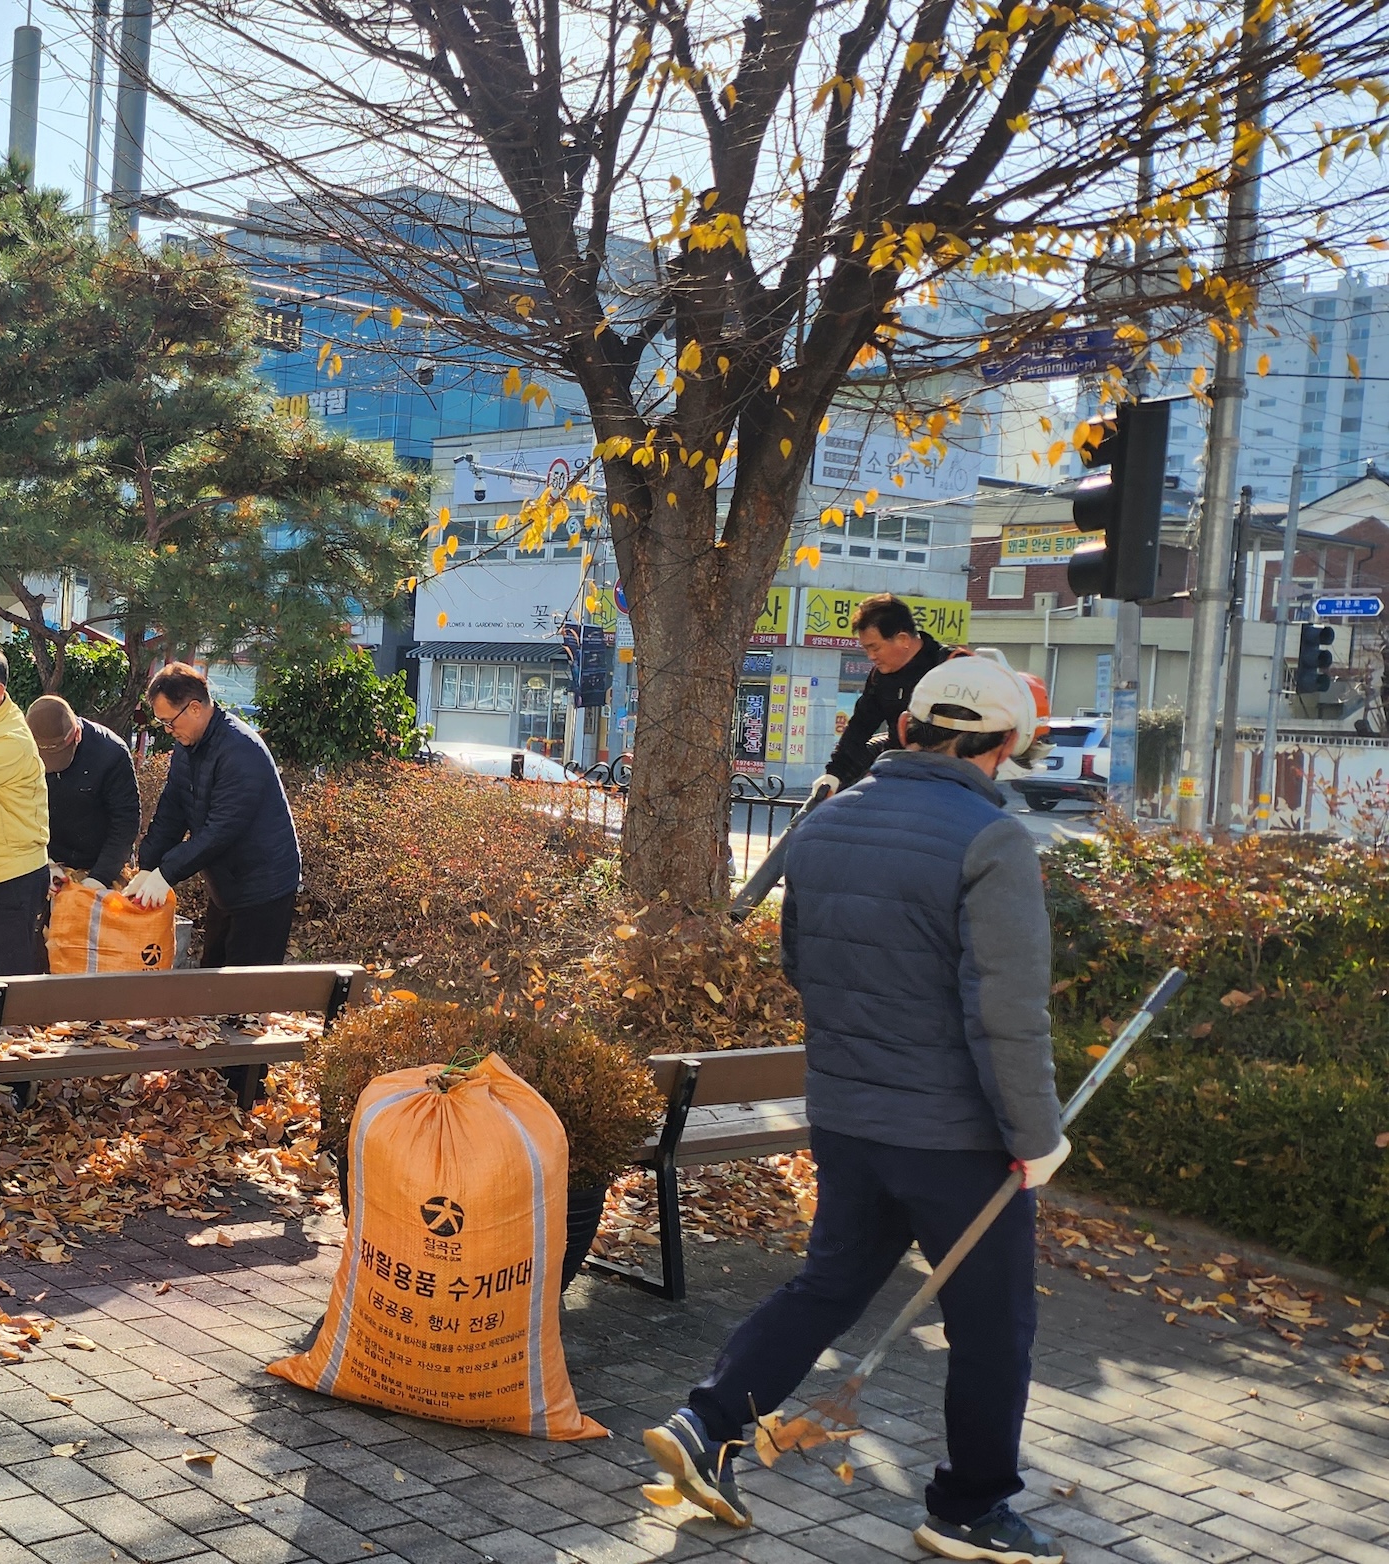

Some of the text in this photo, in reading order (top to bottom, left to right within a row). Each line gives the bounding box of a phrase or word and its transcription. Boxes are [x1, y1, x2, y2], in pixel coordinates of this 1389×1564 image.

[865, 450, 939, 487] 소원수학
[1007, 538, 1028, 554] 왜관
[1032, 537, 1051, 553] 안심
[834, 599, 965, 637] 명 중개사
[772, 684, 786, 695] 원룸
[793, 686, 808, 698] 원룸
[943, 683, 980, 703] ON
[771, 703, 784, 713] 임대
[792, 705, 806, 716] 임대
[742, 694, 765, 753] 명가부동산
[770, 723, 783, 733] 월세
[791, 725, 805, 736] 월세
[769, 742, 782, 752] 전세
[789, 744, 804, 755] 전세
[423, 1236, 462, 1256] 칠곡군
[423, 1252, 449, 1261] CHILGOK
[361, 1238, 533, 1302] 재활용품 수거마대
[368, 1286, 505, 1334] (공공용, 행사 전용)
[378, 1323, 394, 1338] 공공용
[396, 1332, 402, 1341] 및
[404, 1334, 427, 1350] 행사전용
[429, 1342, 454, 1353] 재활용품
[456, 1341, 486, 1354] 수거용으로
[364, 1335, 385, 1354] 마대는
[389, 1349, 413, 1366] 칠곡군
[417, 1360, 452, 1373] 자산으로
[456, 1360, 498, 1374] 개인적으로
[502, 1350, 524, 1365] 사용할
[364, 1344, 395, 1369] 없습니다.
[350, 1366, 452, 1409] 이하의 과태료가 부과됩니다.
[352, 1356, 378, 1379] 쓰레기를
[380, 1373, 403, 1389] 함부로
[405, 1384, 438, 1398] 버리거나
[440, 1390, 465, 1401] 태우는
[468, 1390, 493, 1400] 행위는
[496, 1380, 525, 1396] 100만원
